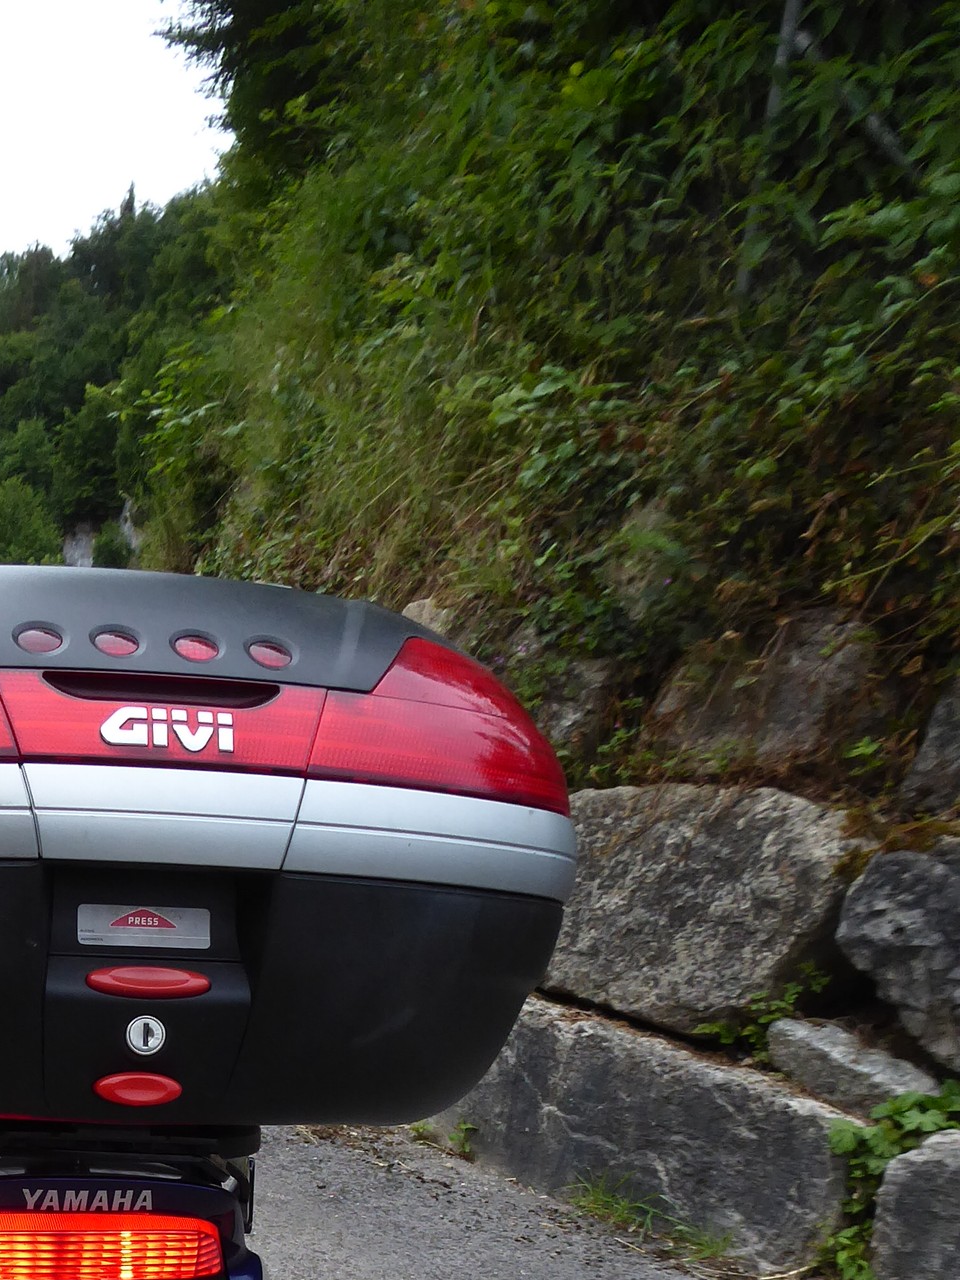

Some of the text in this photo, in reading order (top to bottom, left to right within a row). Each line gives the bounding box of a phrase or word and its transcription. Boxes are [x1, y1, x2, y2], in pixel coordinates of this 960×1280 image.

[100, 706, 235, 753] GIVI
[127, 916, 160, 926] PRESS
[22, 1188, 153, 1211] YAMAHA
